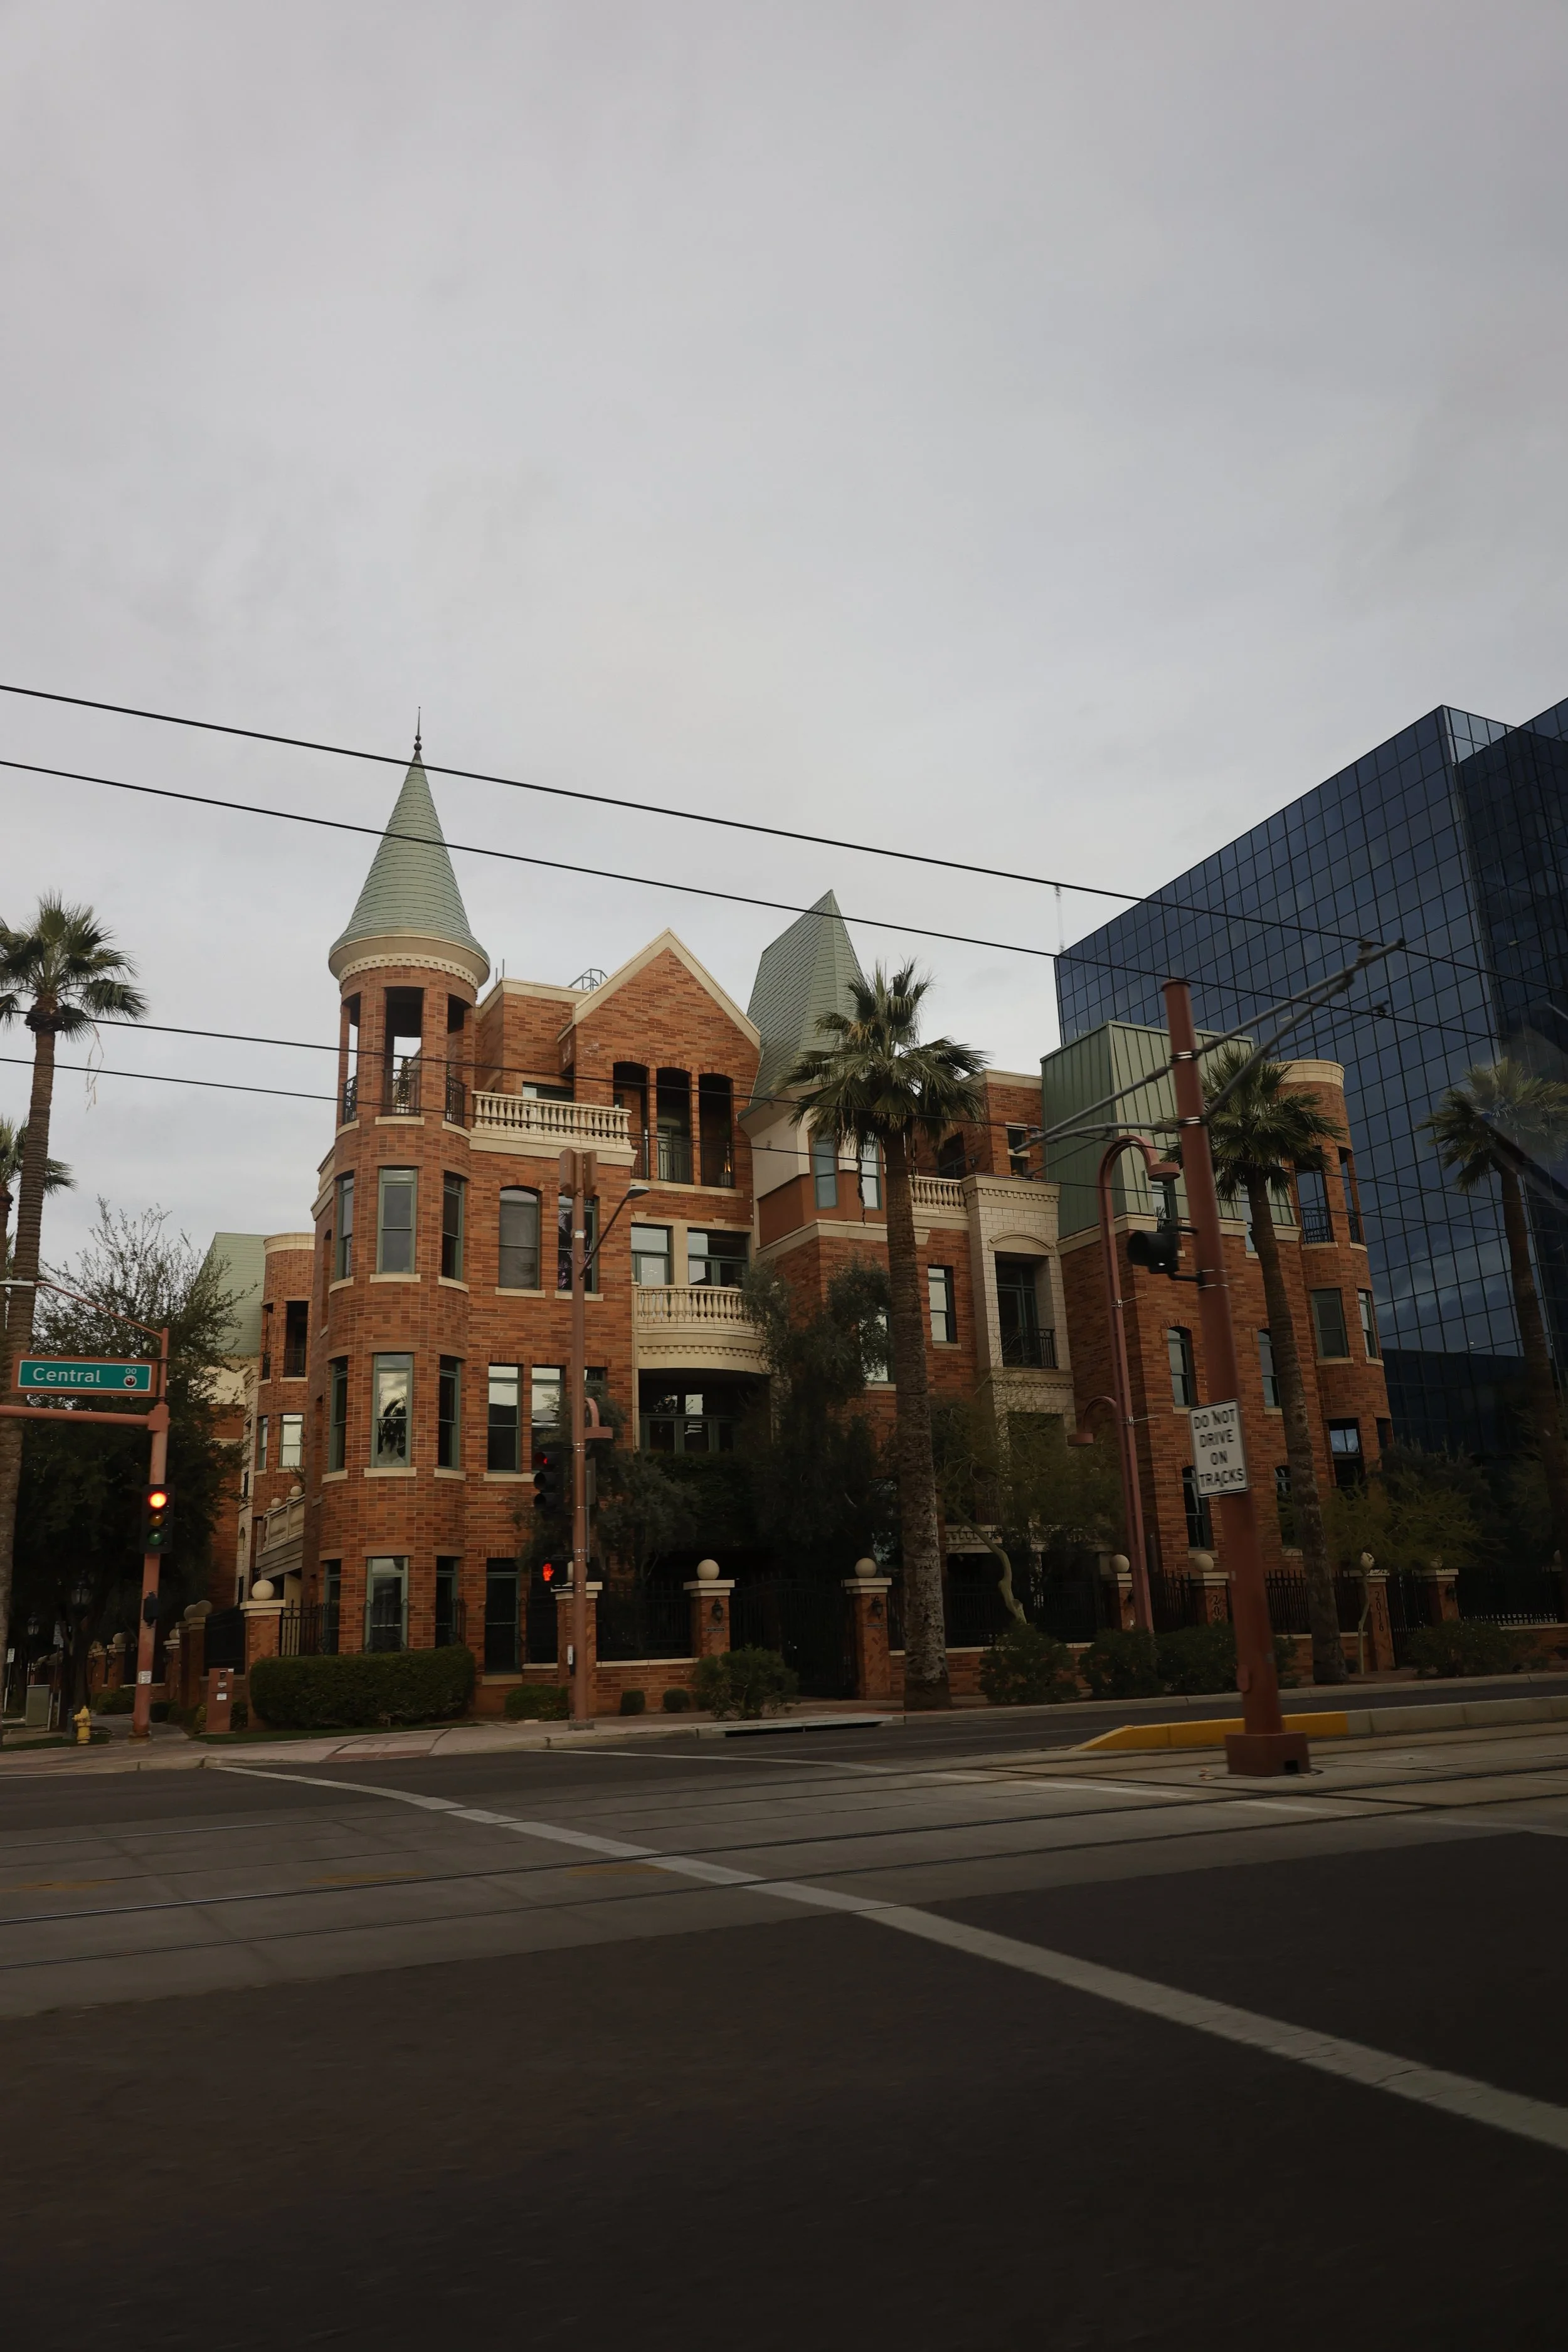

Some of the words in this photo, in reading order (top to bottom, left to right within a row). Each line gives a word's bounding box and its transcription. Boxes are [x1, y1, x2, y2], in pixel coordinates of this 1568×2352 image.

[33, 1367, 101, 1383] Central
[1194, 1414, 1209, 1429] DO
[1211, 1409, 1235, 1426] NOT
[1199, 1429, 1234, 1448] DRIVE
[1210, 1451, 1228, 1465] ON
[1199, 1468, 1244, 1488] TRACKS
[1374, 1591, 1384, 1631] 2016
